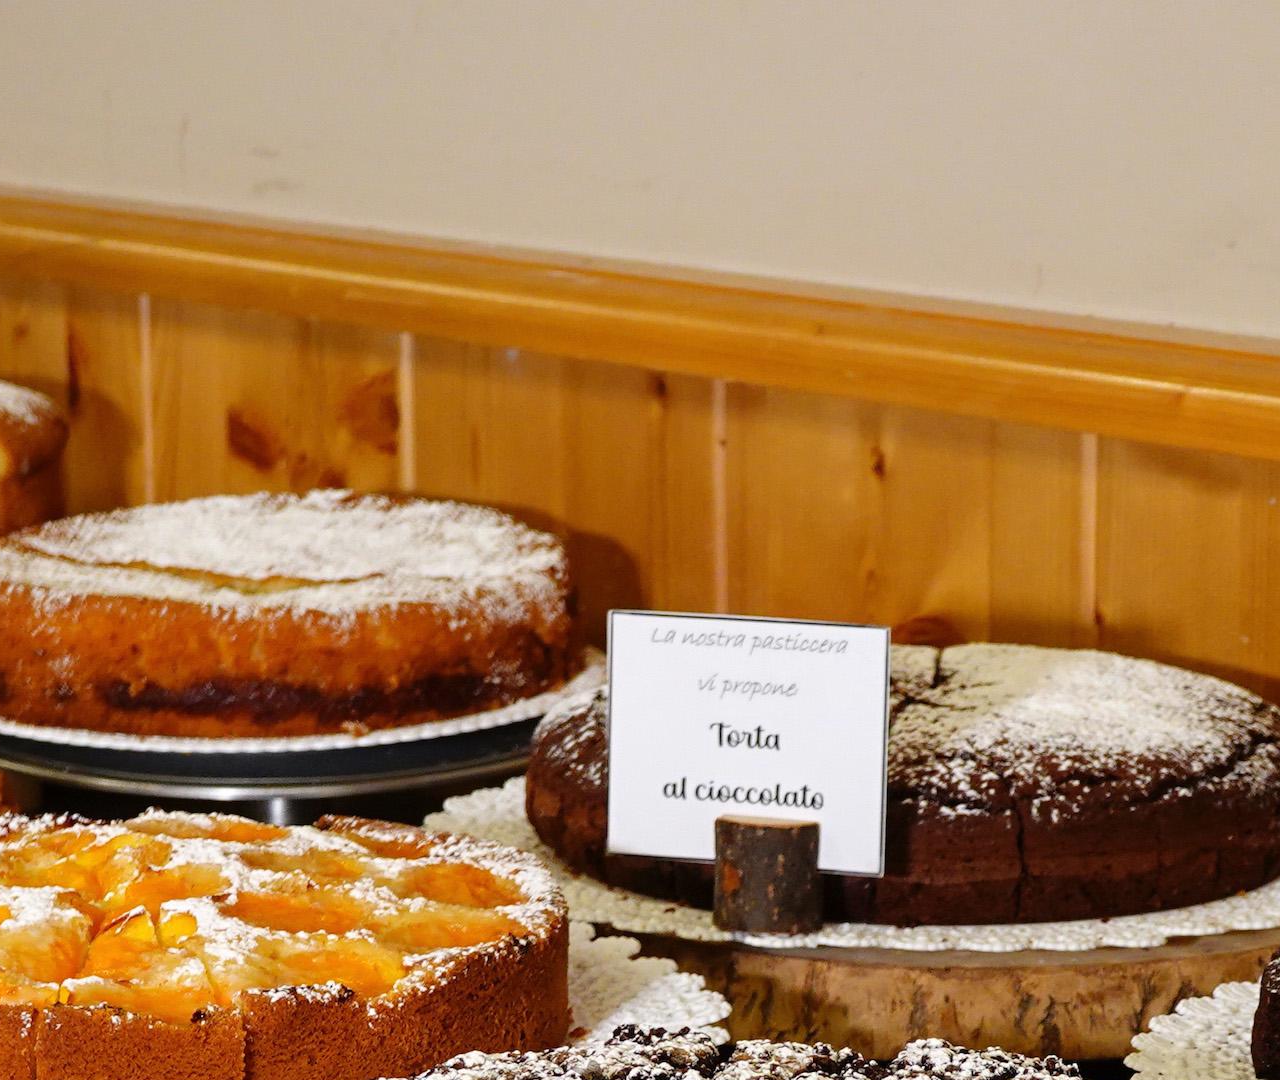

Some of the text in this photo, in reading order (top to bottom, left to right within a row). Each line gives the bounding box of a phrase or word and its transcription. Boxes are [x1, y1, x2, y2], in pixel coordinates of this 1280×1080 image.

[651, 627, 849, 656] La nostra pasticcera
[698, 673, 718, 691] vi
[709, 721, 781, 751] Torta
[663, 776, 825, 810] al cioccolato
